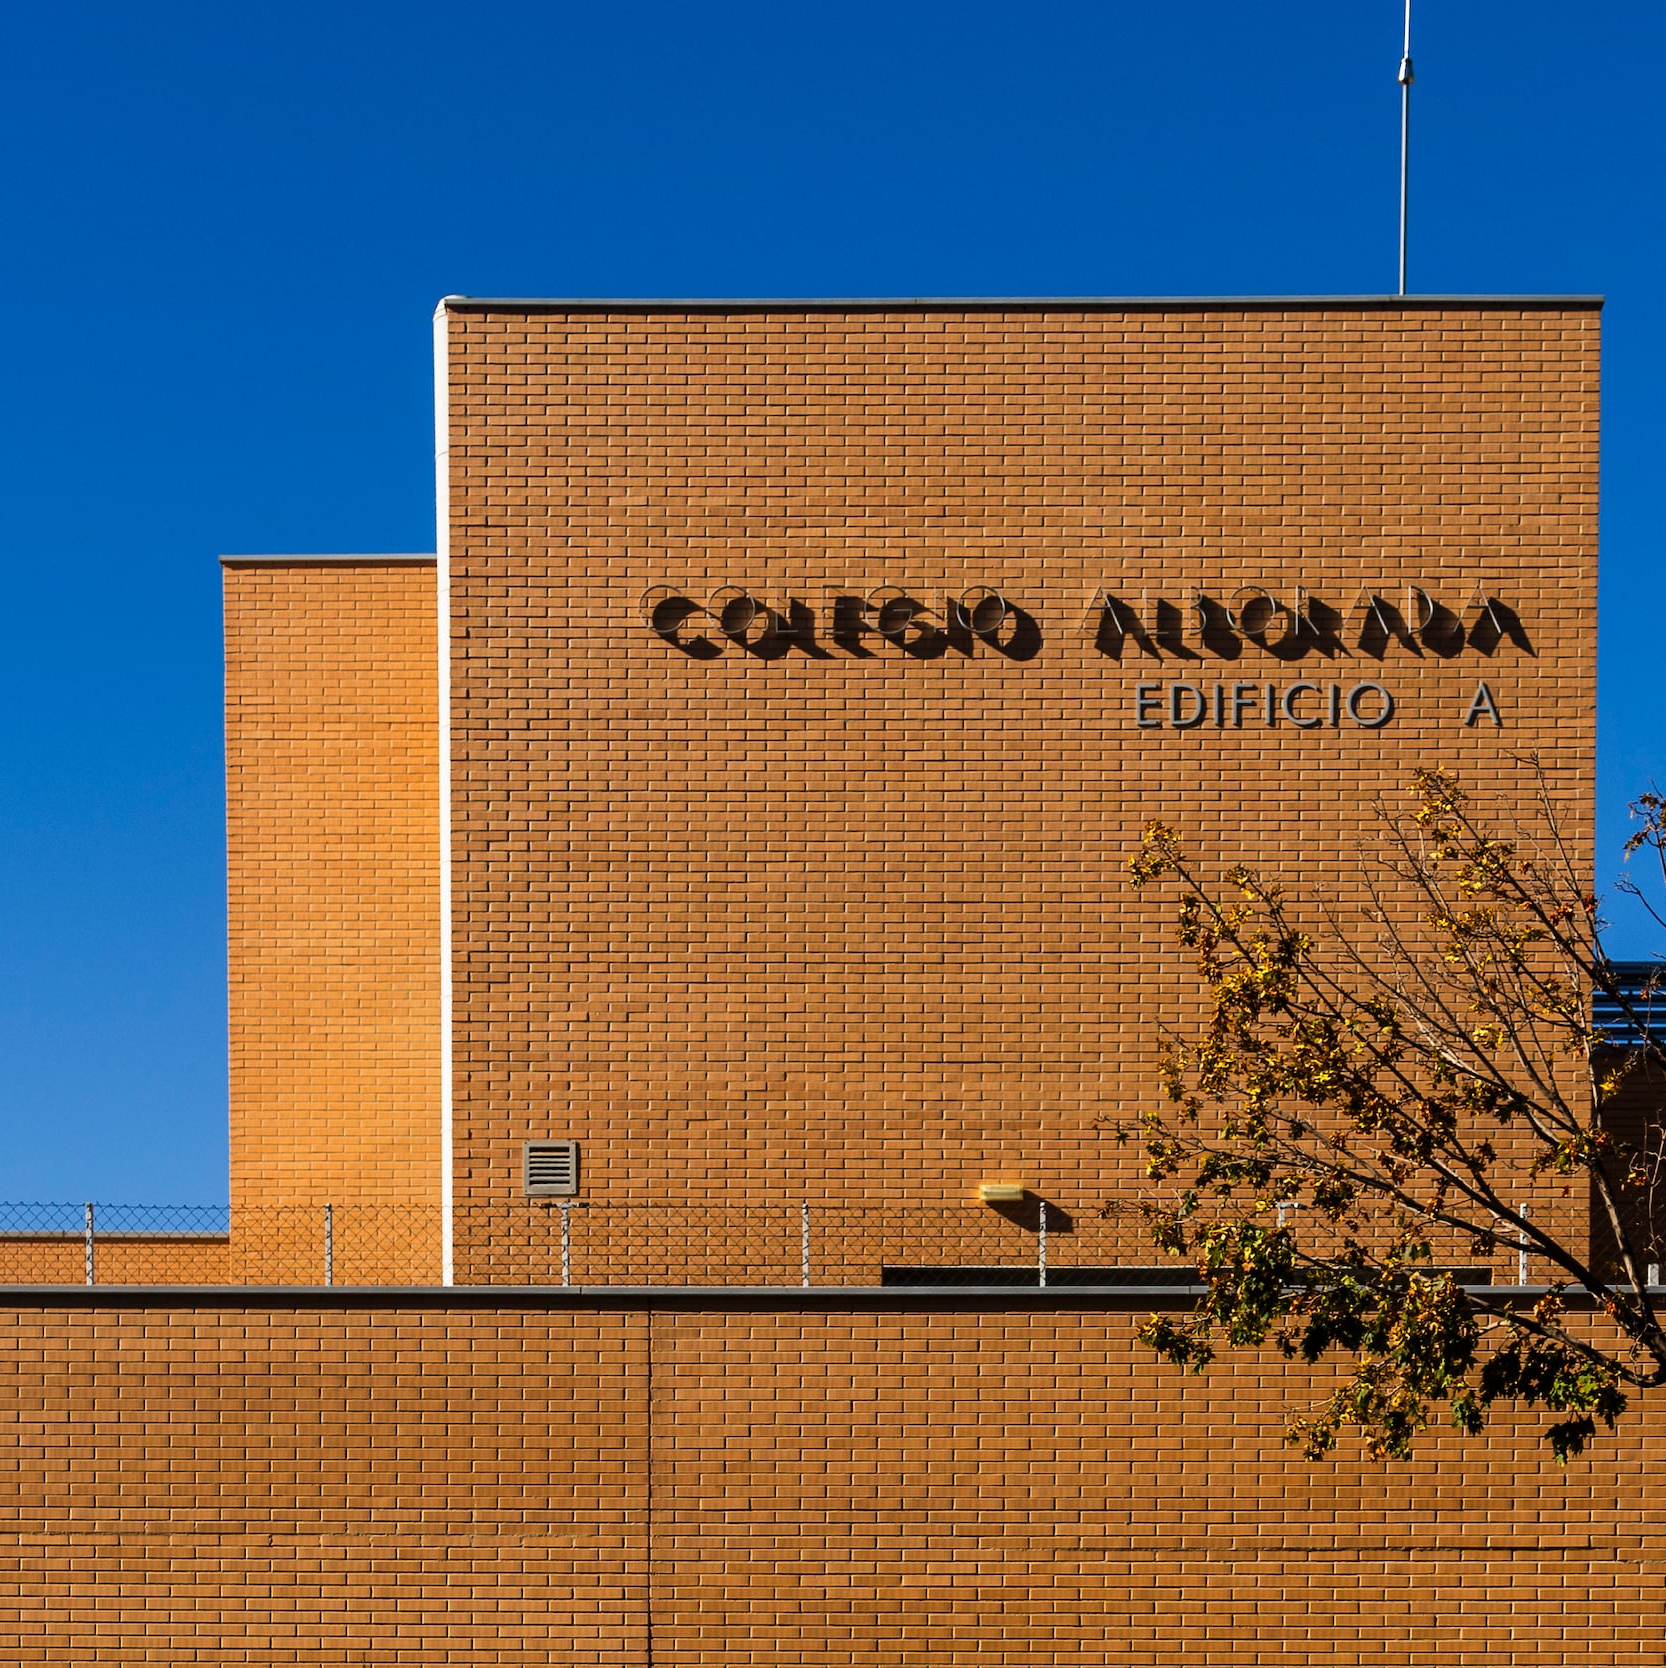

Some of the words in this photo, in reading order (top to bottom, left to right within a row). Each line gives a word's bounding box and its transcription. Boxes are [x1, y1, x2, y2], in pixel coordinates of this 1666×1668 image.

[637, 583, 1006, 636] COLEGIO
[1076, 583, 1502, 636] ALBORADA
[1135, 682, 1394, 728] EDIFICIO
[1464, 680, 1502, 727] A
